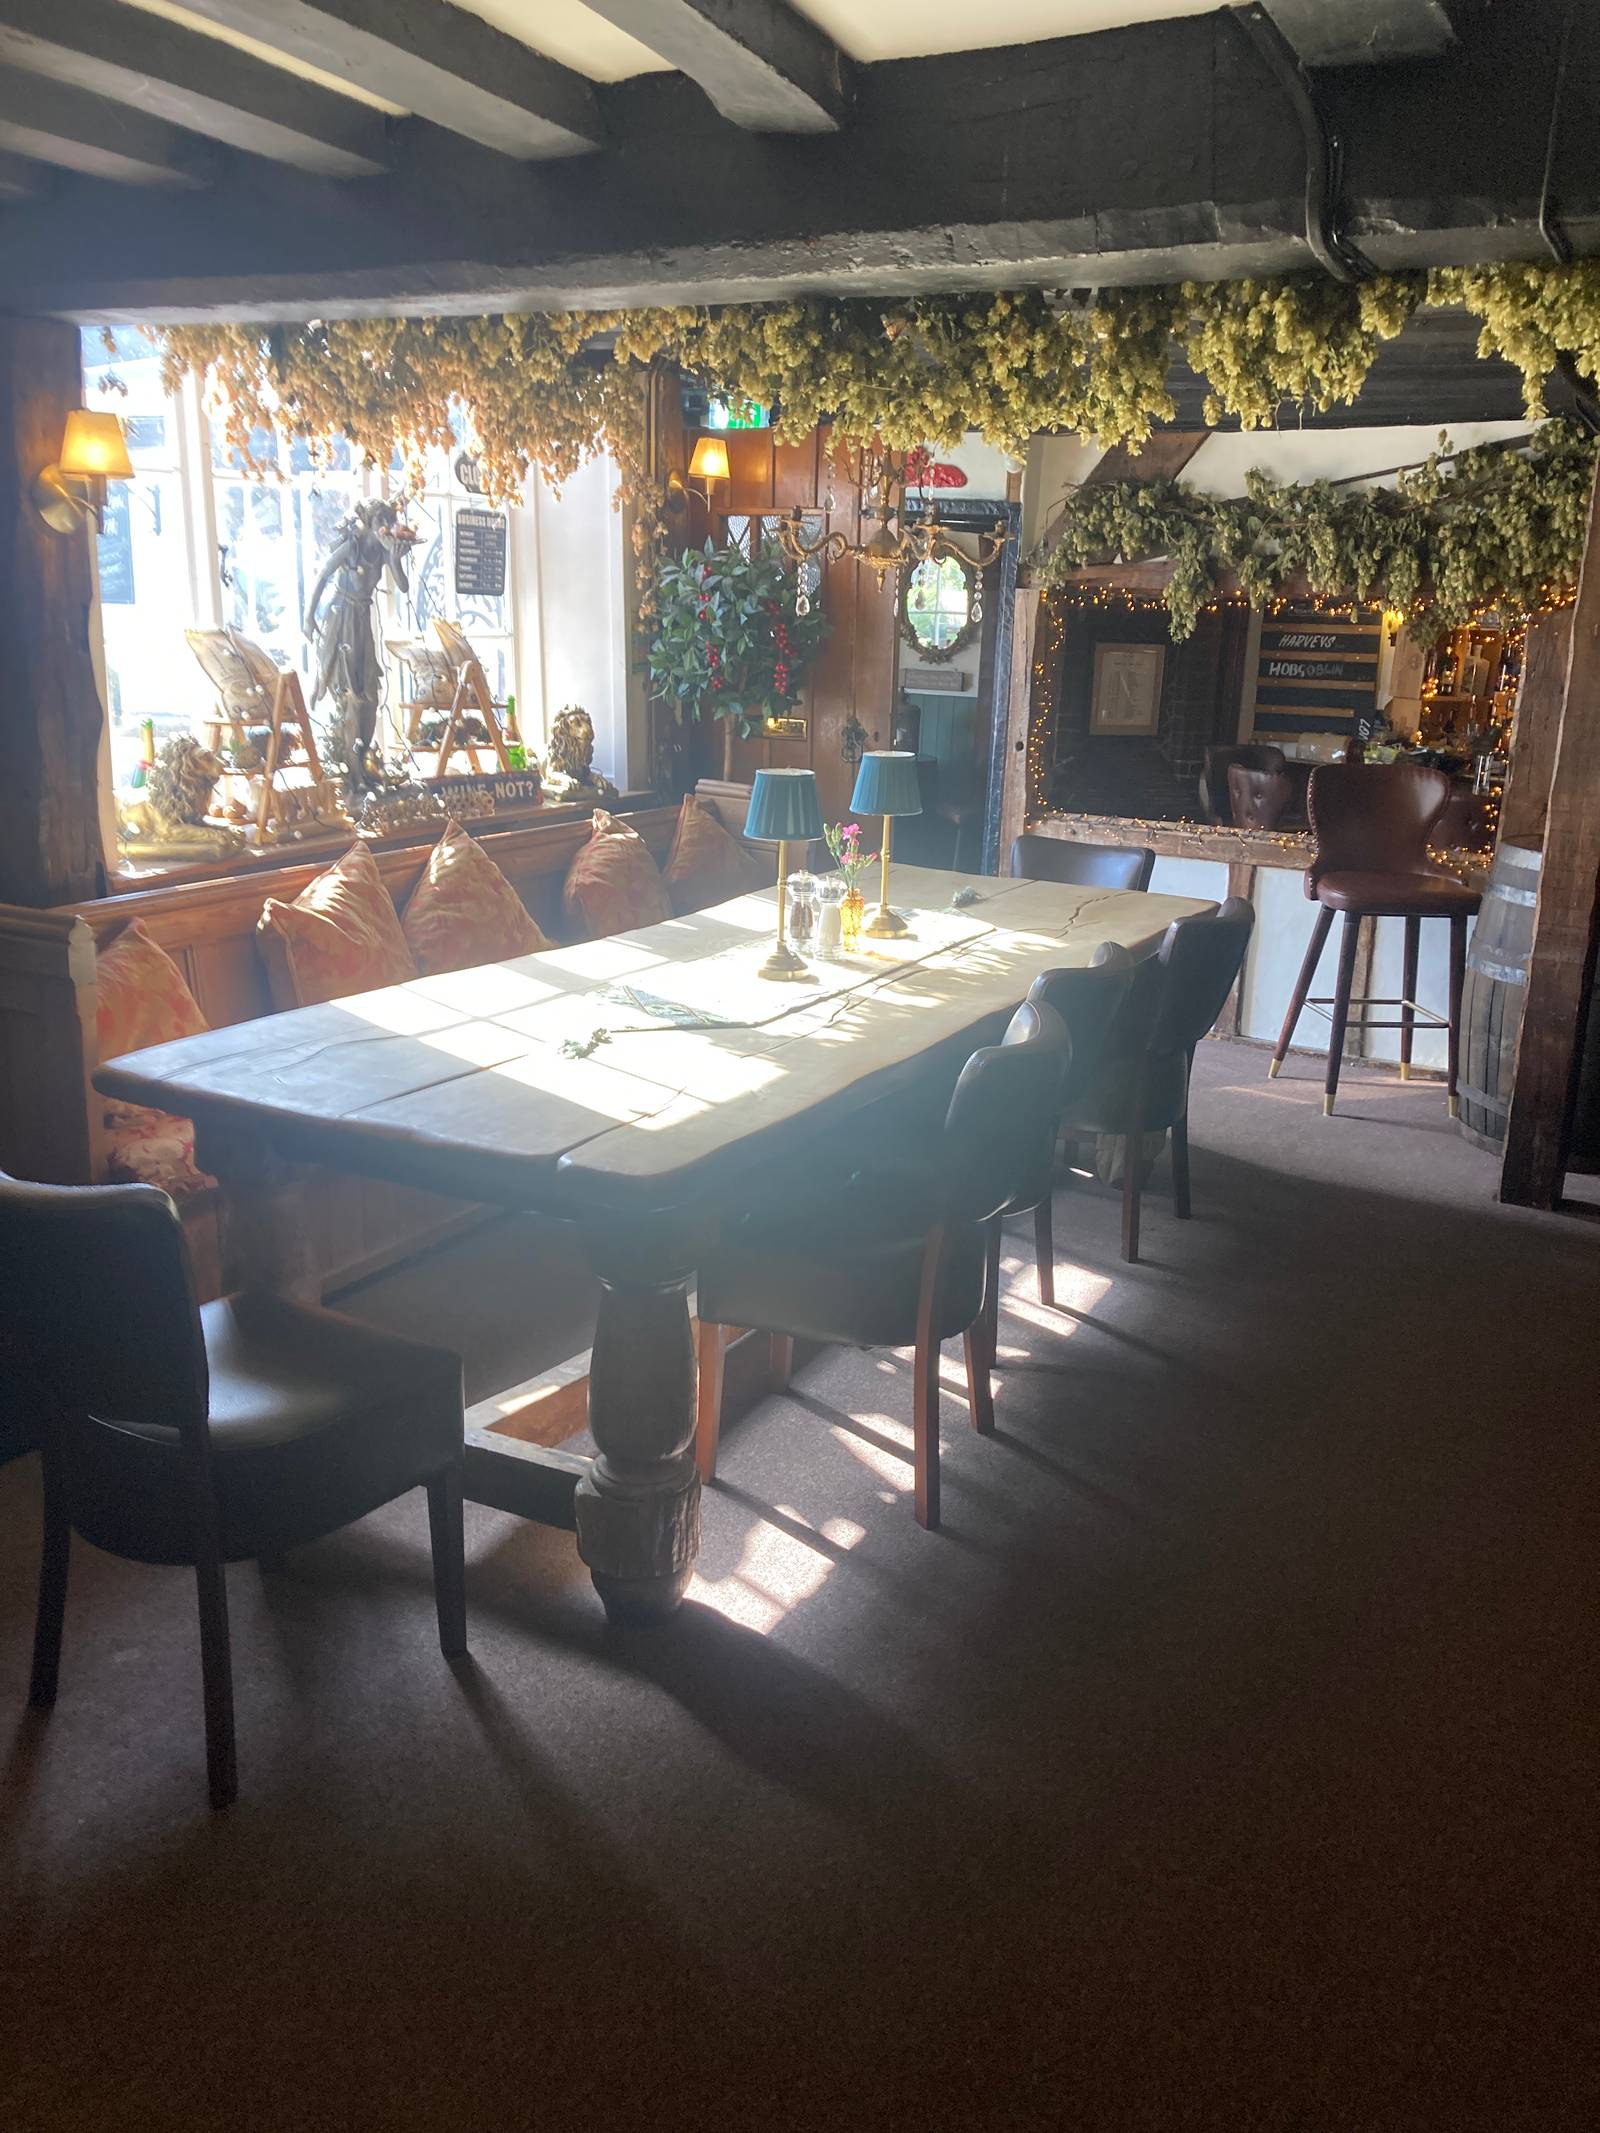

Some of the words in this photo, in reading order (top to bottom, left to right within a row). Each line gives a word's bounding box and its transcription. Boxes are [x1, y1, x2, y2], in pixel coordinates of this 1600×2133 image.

[1279, 634, 1336, 648] HARVEYS
[1268, 662, 1344, 678] HOBGOBLIN
[494, 781, 534, 798] NOT?
